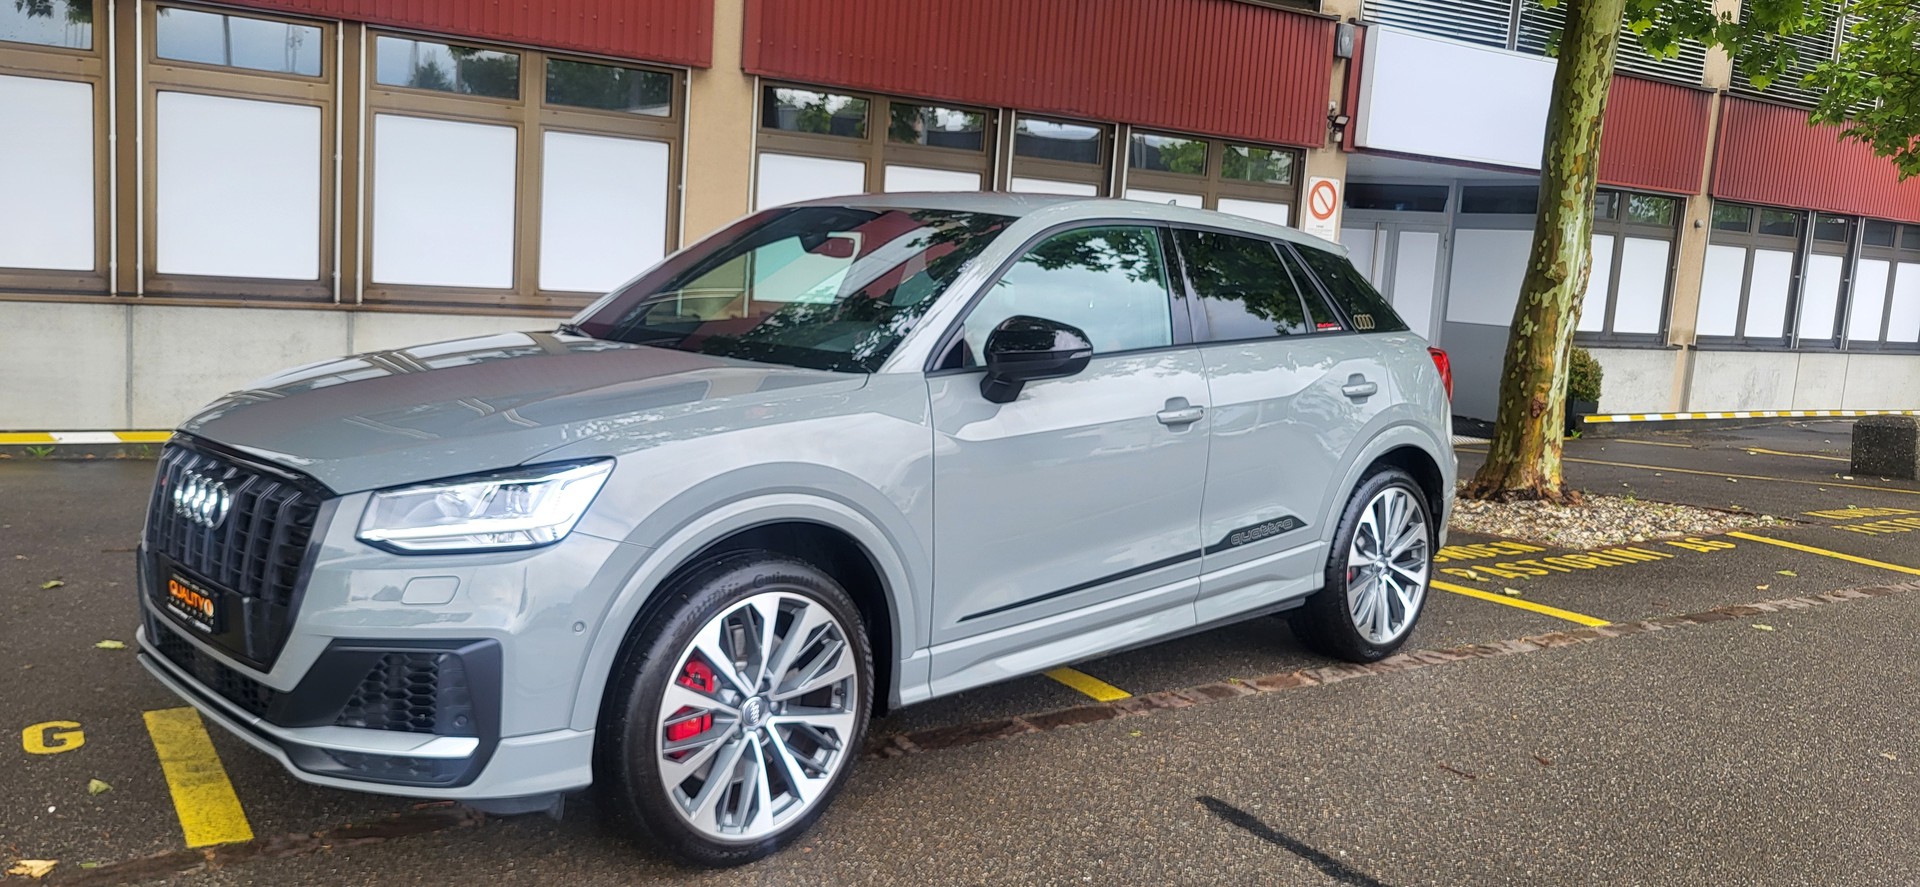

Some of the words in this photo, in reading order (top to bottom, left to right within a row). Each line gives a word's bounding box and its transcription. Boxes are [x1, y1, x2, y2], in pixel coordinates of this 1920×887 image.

[1230, 518, 1293, 545] quattro
[1665, 537, 1736, 553] AG
[753, 571, 815, 588] Continental
[22, 720, 85, 754] G
